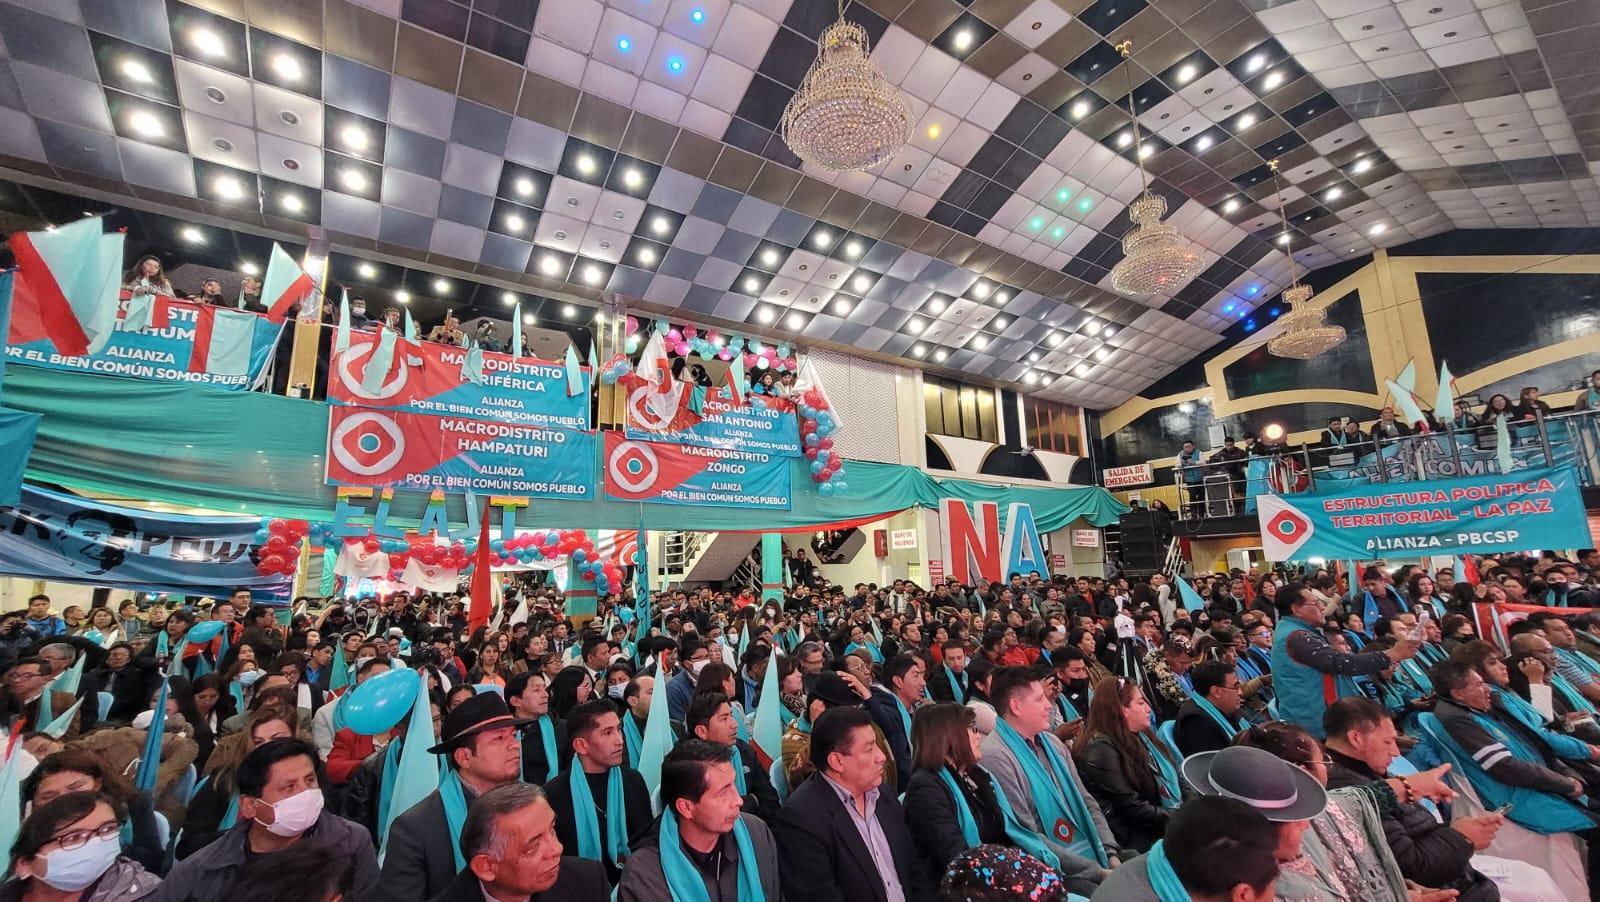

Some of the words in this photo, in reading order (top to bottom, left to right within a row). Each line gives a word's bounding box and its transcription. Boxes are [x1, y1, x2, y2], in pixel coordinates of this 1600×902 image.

[106, 345, 175, 364] ALIANZA
[25, 350, 47, 362] EL
[49, 353, 90, 369] BIEN
[92, 360, 154, 377] COMÚN
[155, 368, 210, 383] SOMOS
[482, 396, 525, 408] ALIANZA
[702, 400, 730, 412] ACRO
[410, 400, 434, 410] POR
[436, 402, 448, 412] EL
[449, 404, 474, 414] BIEN
[474, 406, 513, 419] COMÚN
[513, 410, 548, 423] SOMOS
[549, 414, 586, 426] PUEBLO
[701, 413, 723, 424] SAN
[725, 416, 773, 430] ANTONIO
[440, 418, 566, 443] MACRODISTRITO
[724, 429, 753, 439] ALIANZA
[458, 438, 548, 458] HAMPATURI
[748, 440, 771, 450] SOMOS
[772, 442, 798, 451] PUEBLO
[681, 446, 769, 463] MACRODISTRITO
[480, 464, 524, 477] ALIANZA
[707, 462, 746, 474] ZONGO
[1108, 467, 1133, 477] SALIDA
[1135, 465, 1145, 474] DE
[406, 473, 430, 485] POR
[432, 475, 444, 486] EL
[446, 476, 471, 488] BIEN
[472, 477, 511, 491] COMÚN
[512, 480, 548, 492] SOMOS
[549, 483, 586, 495] PUEBLO
[711, 481, 743, 492] ALIANZA
[1105, 473, 1150, 486] EMERGENCIA
[661, 489, 678, 500] POR
[679, 491, 688, 500] EL
[689, 492, 706, 501] BIEN
[706, 492, 734, 502] COMÚN
[734, 494, 759, 504] SOMOS
[760, 496, 788, 506] PUEBLO
[1323, 489, 1449, 513] ESTRUCTURA
[1450, 478, 1557, 502] POLITICA
[1330, 508, 1459, 528] TERRITORIAL
[1473, 503, 1503, 519] LA
[1506, 498, 1554, 516] PAZ
[1366, 535, 1441, 550] ALIANZA
[1456, 530, 1519, 545] PBCSP
